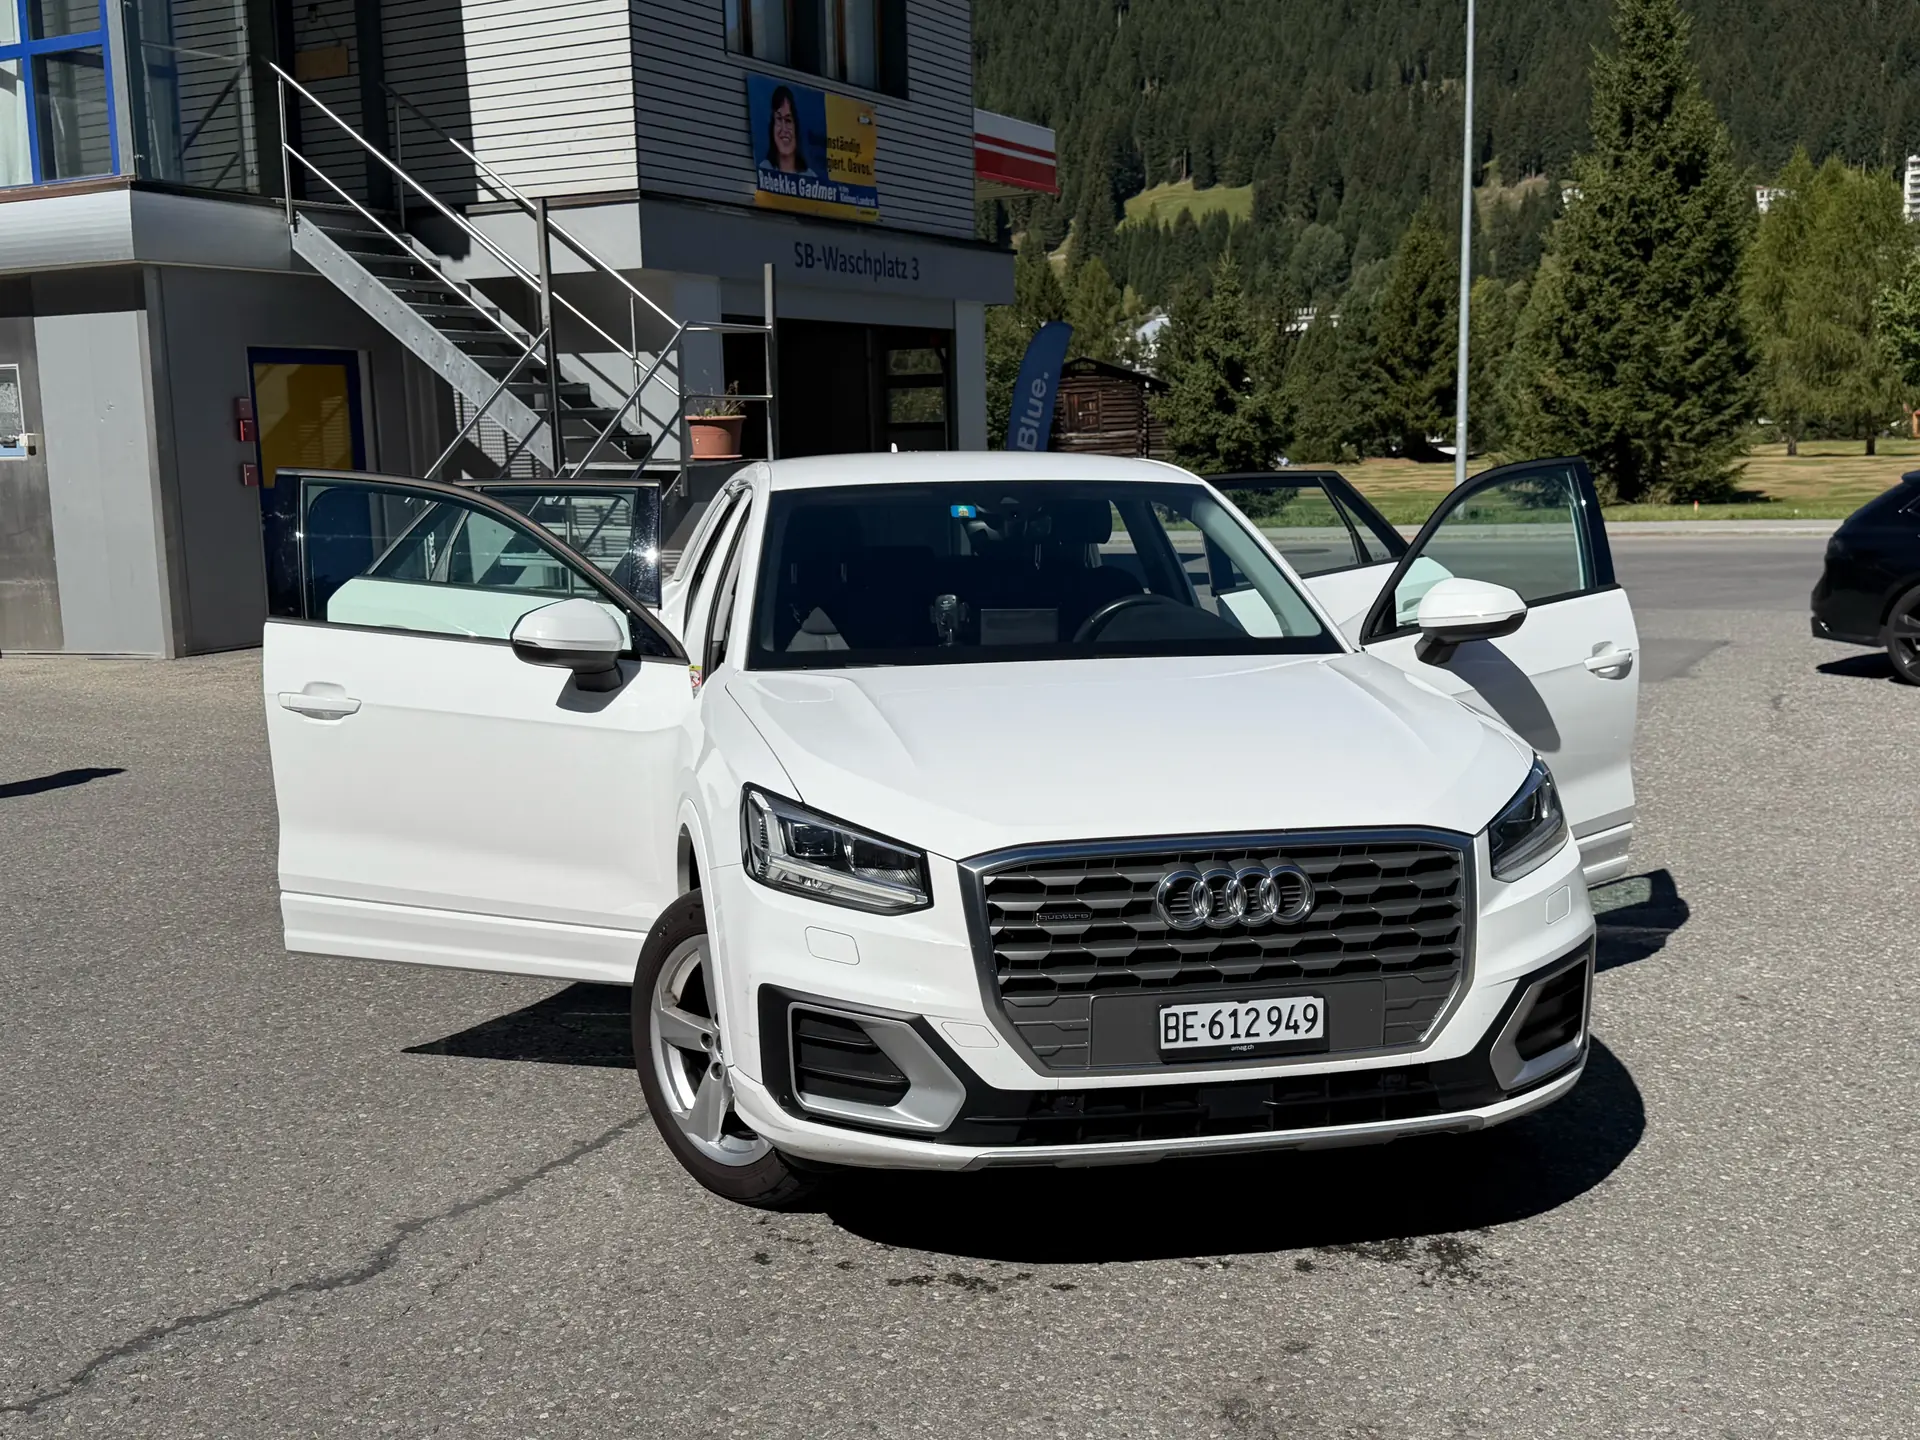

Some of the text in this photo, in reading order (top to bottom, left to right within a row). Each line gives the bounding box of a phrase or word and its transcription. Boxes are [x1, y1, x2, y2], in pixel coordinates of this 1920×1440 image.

[758, 169, 838, 201] Rebekka Gadmer
[794, 241, 920, 282] SB-Waschplatz 3
[1017, 372, 1049, 451] Blue.
